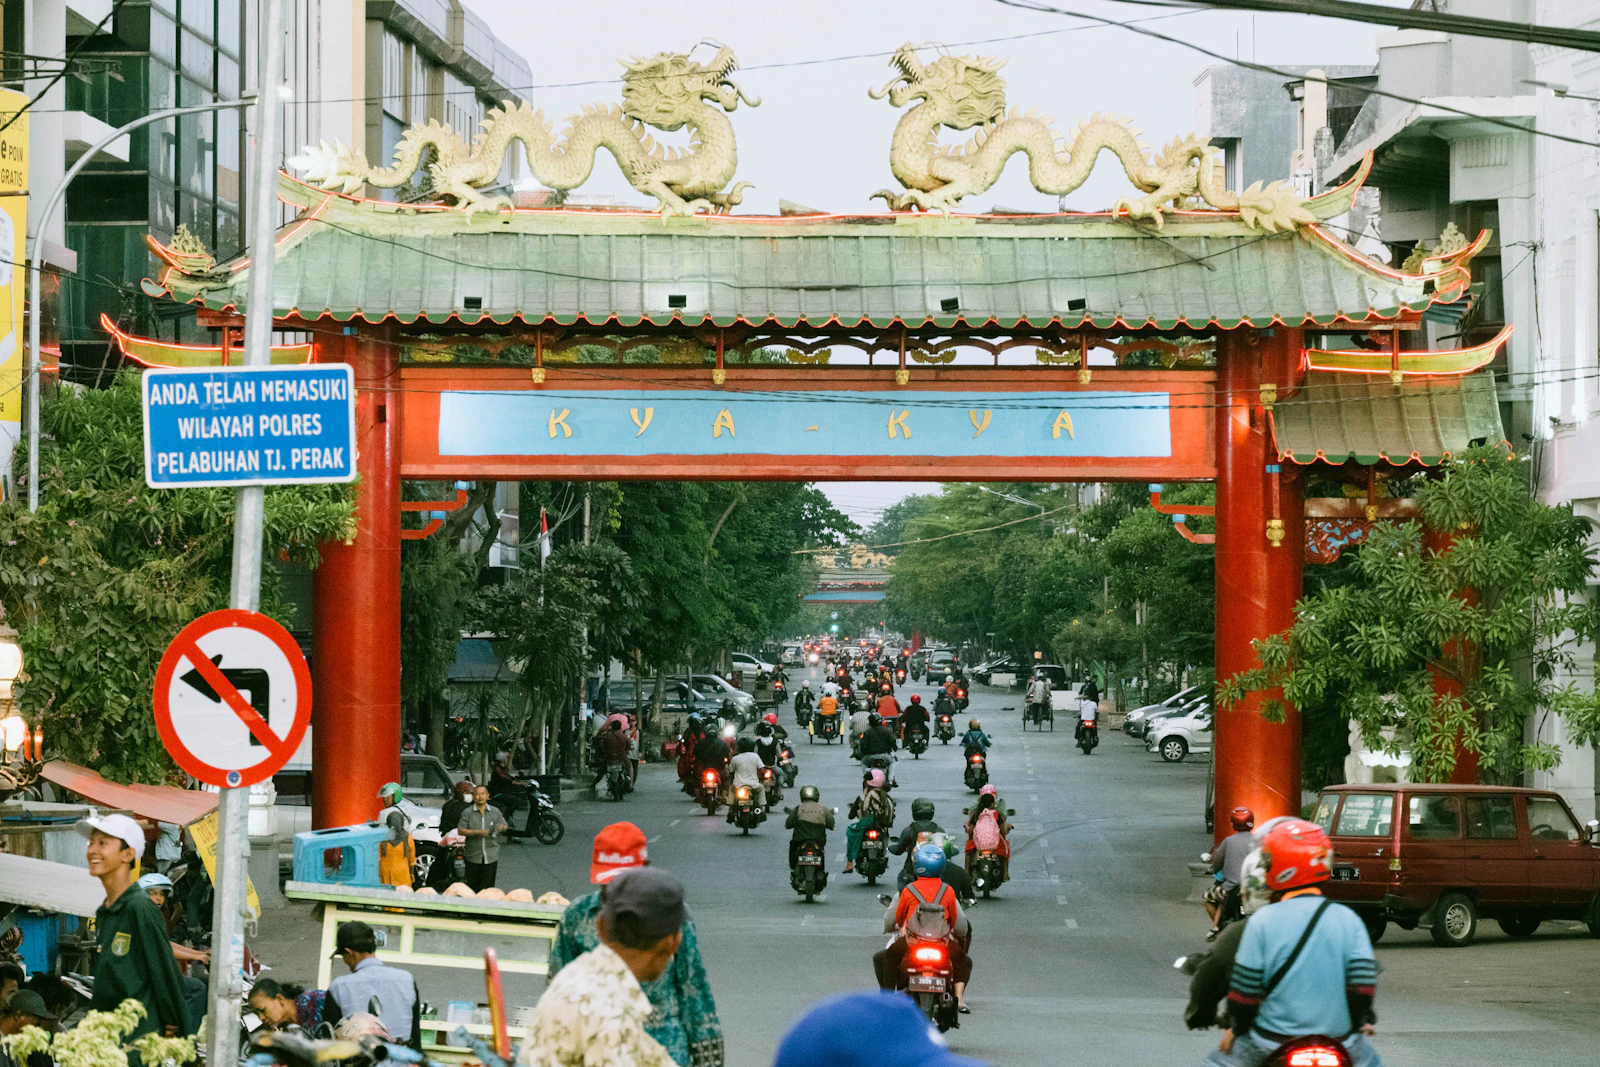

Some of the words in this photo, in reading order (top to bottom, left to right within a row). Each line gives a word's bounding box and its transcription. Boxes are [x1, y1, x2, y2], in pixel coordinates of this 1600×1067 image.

[1, 168, 23, 187] GRATIS
[150, 383, 199, 406] ANDA
[203, 380, 256, 404] TELAH
[261, 378, 347, 402] MEMASUKI
[177, 415, 254, 439] WILAYAH
[259, 413, 322, 437] POLRES
[157, 450, 260, 475] PELABUHAN
[264, 449, 287, 471] TJ.
[291, 447, 345, 470] PERAK
